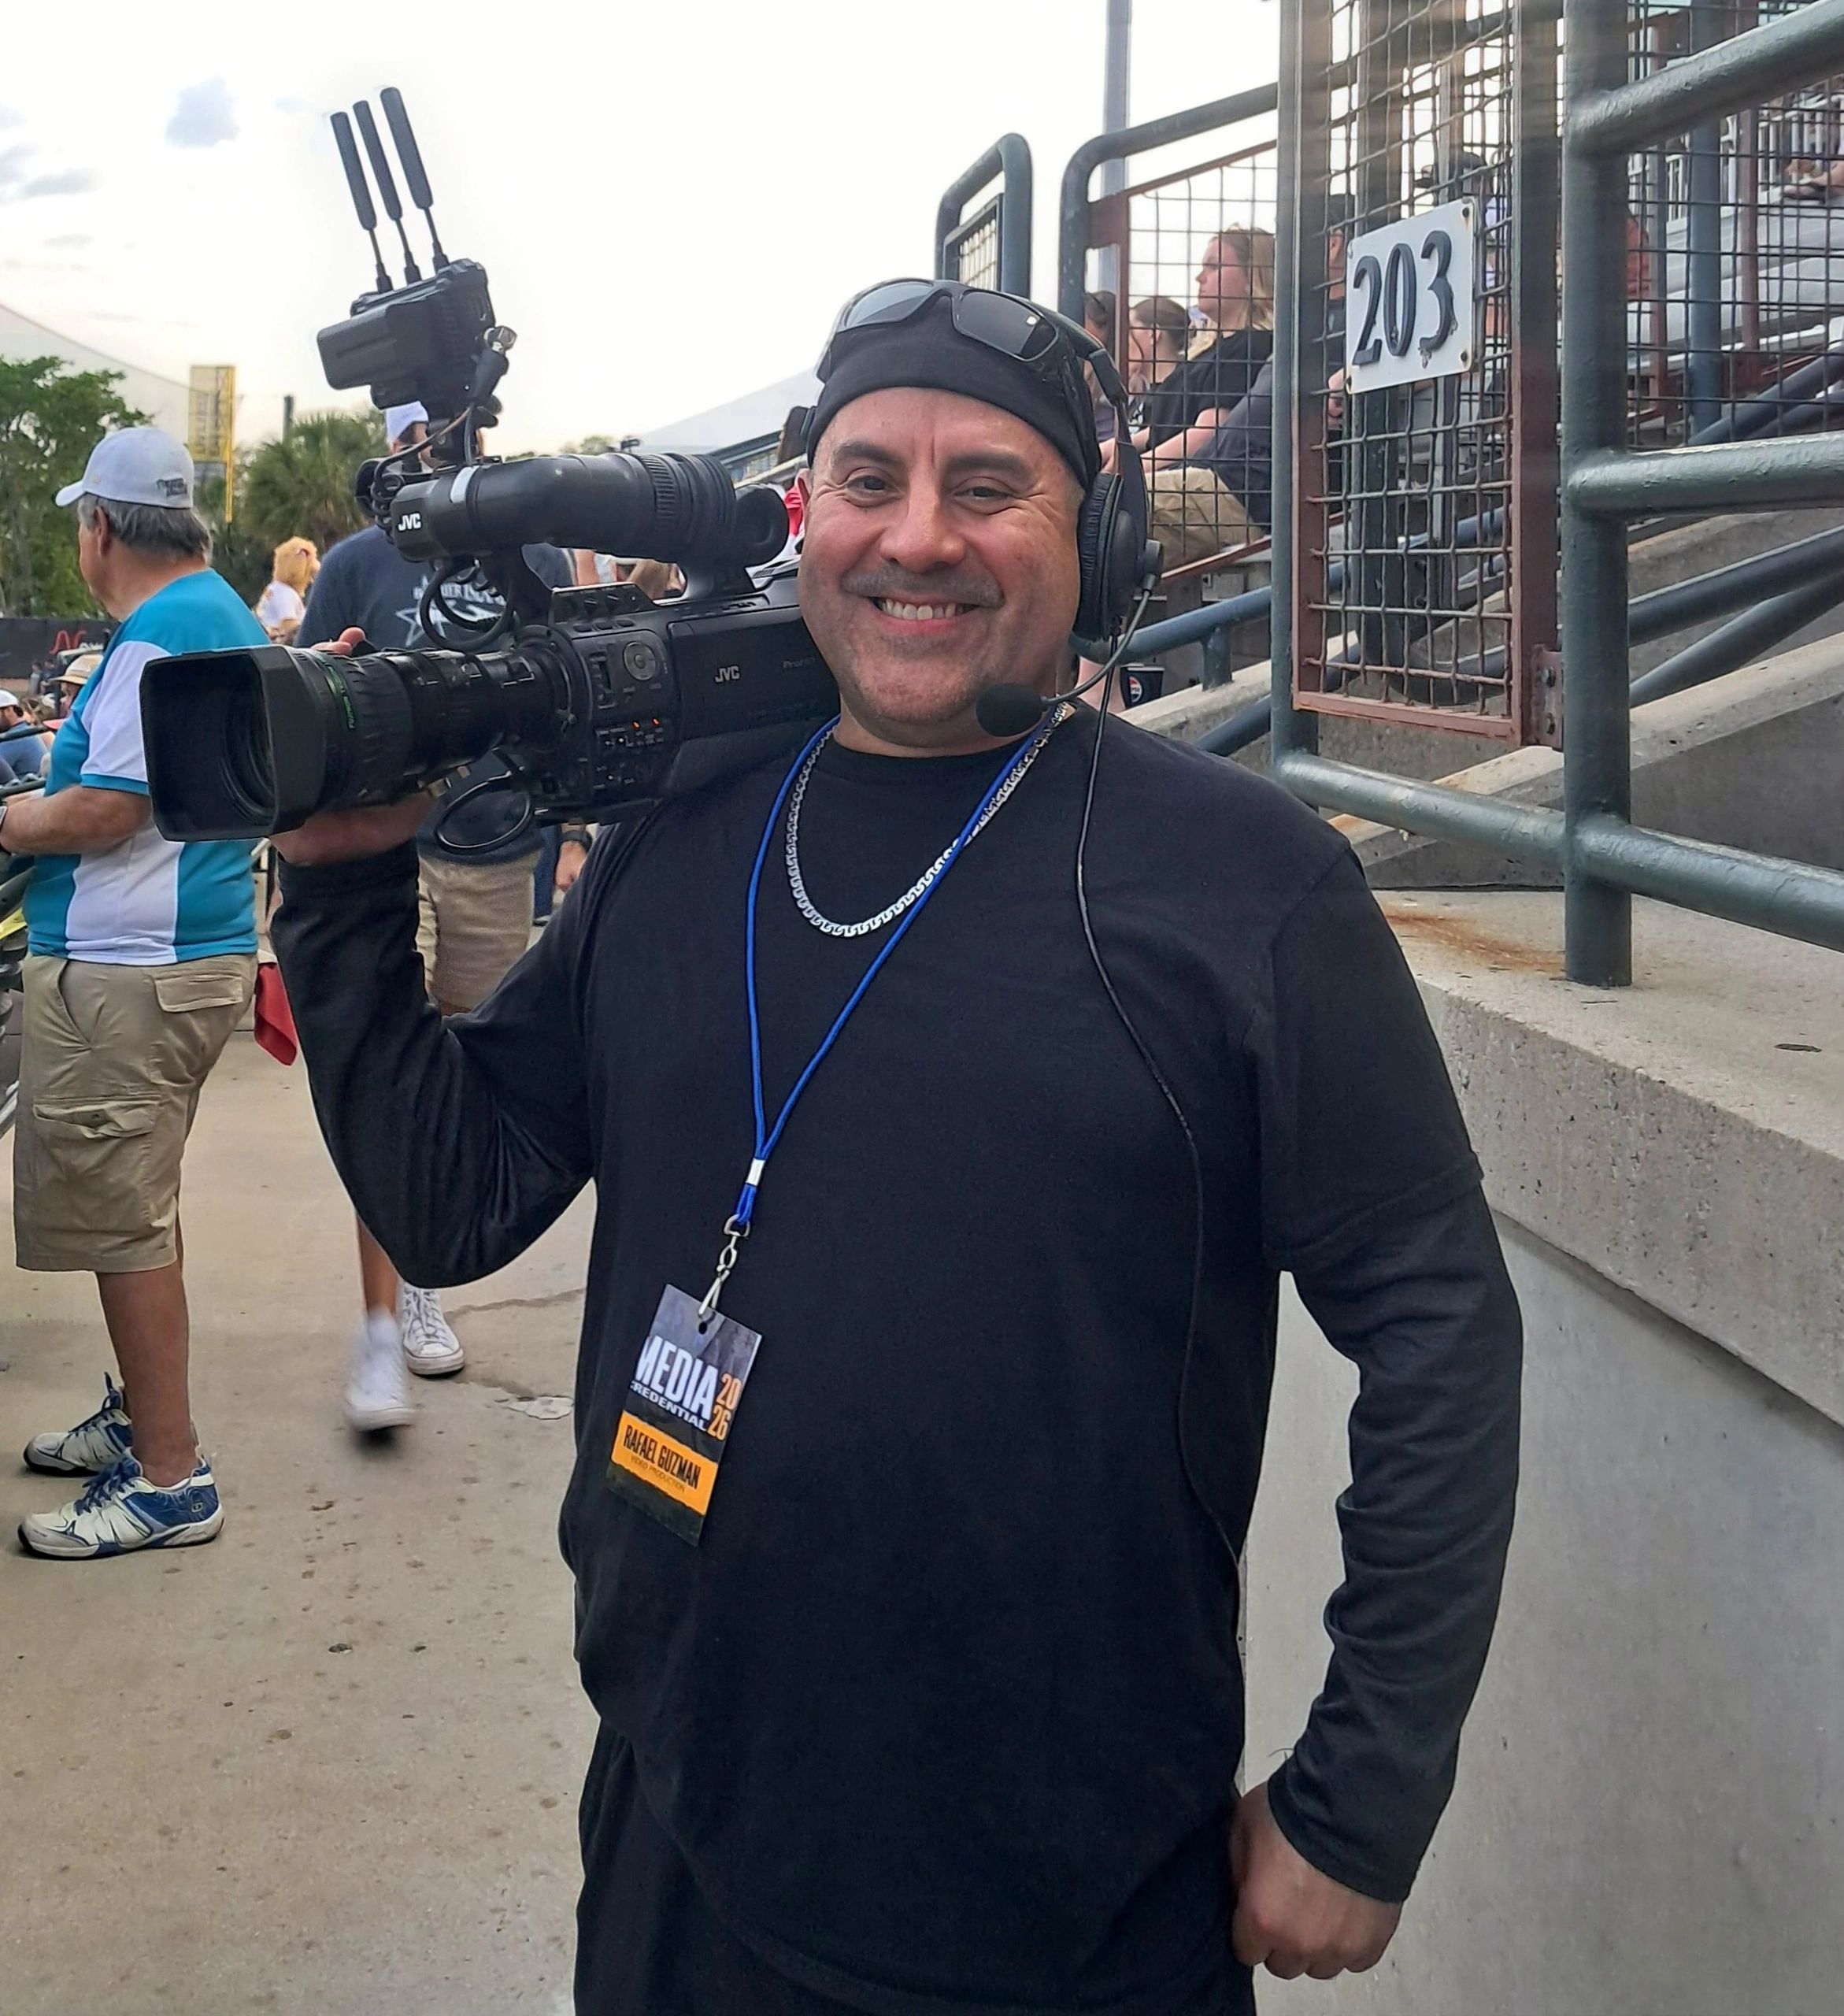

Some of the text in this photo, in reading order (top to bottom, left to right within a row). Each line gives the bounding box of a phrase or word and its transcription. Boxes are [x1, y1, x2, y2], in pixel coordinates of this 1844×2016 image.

[1352, 230, 1457, 366] 203
[398, 513, 422, 532] JVC
[714, 665, 741, 684] JVC
[635, 1335, 719, 1421] MEDIA
[716, 1373, 742, 1410] 20
[707, 1404, 731, 1441] 26
[623, 1424, 702, 1490] RAFAEL GUZMAN
